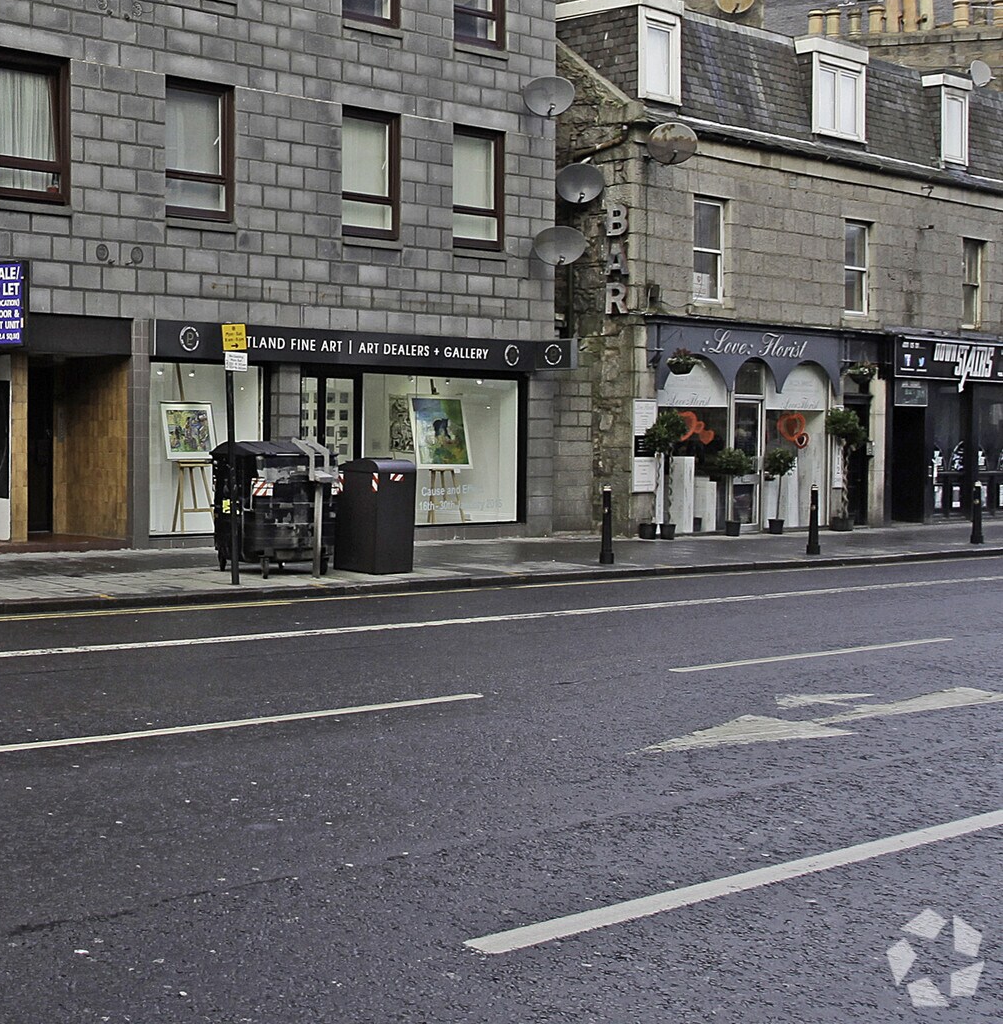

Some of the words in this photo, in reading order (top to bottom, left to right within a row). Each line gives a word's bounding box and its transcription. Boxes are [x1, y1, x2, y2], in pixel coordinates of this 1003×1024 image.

[605, 204, 629, 314] BAR
[3, 282, 20, 296] LET
[14, 309, 20, 318] &
[5, 320, 20, 329] UNIT
[290, 338, 316, 352] FINE
[320, 341, 343, 353] ART
[358, 342, 379, 354] ART
[383, 342, 430, 357] DEALERS
[444, 346, 489, 360] GALLERY
[758, 332, 808, 358] Florist
[421, 486, 446, 496] Cause
[447, 485, 461, 495] and
